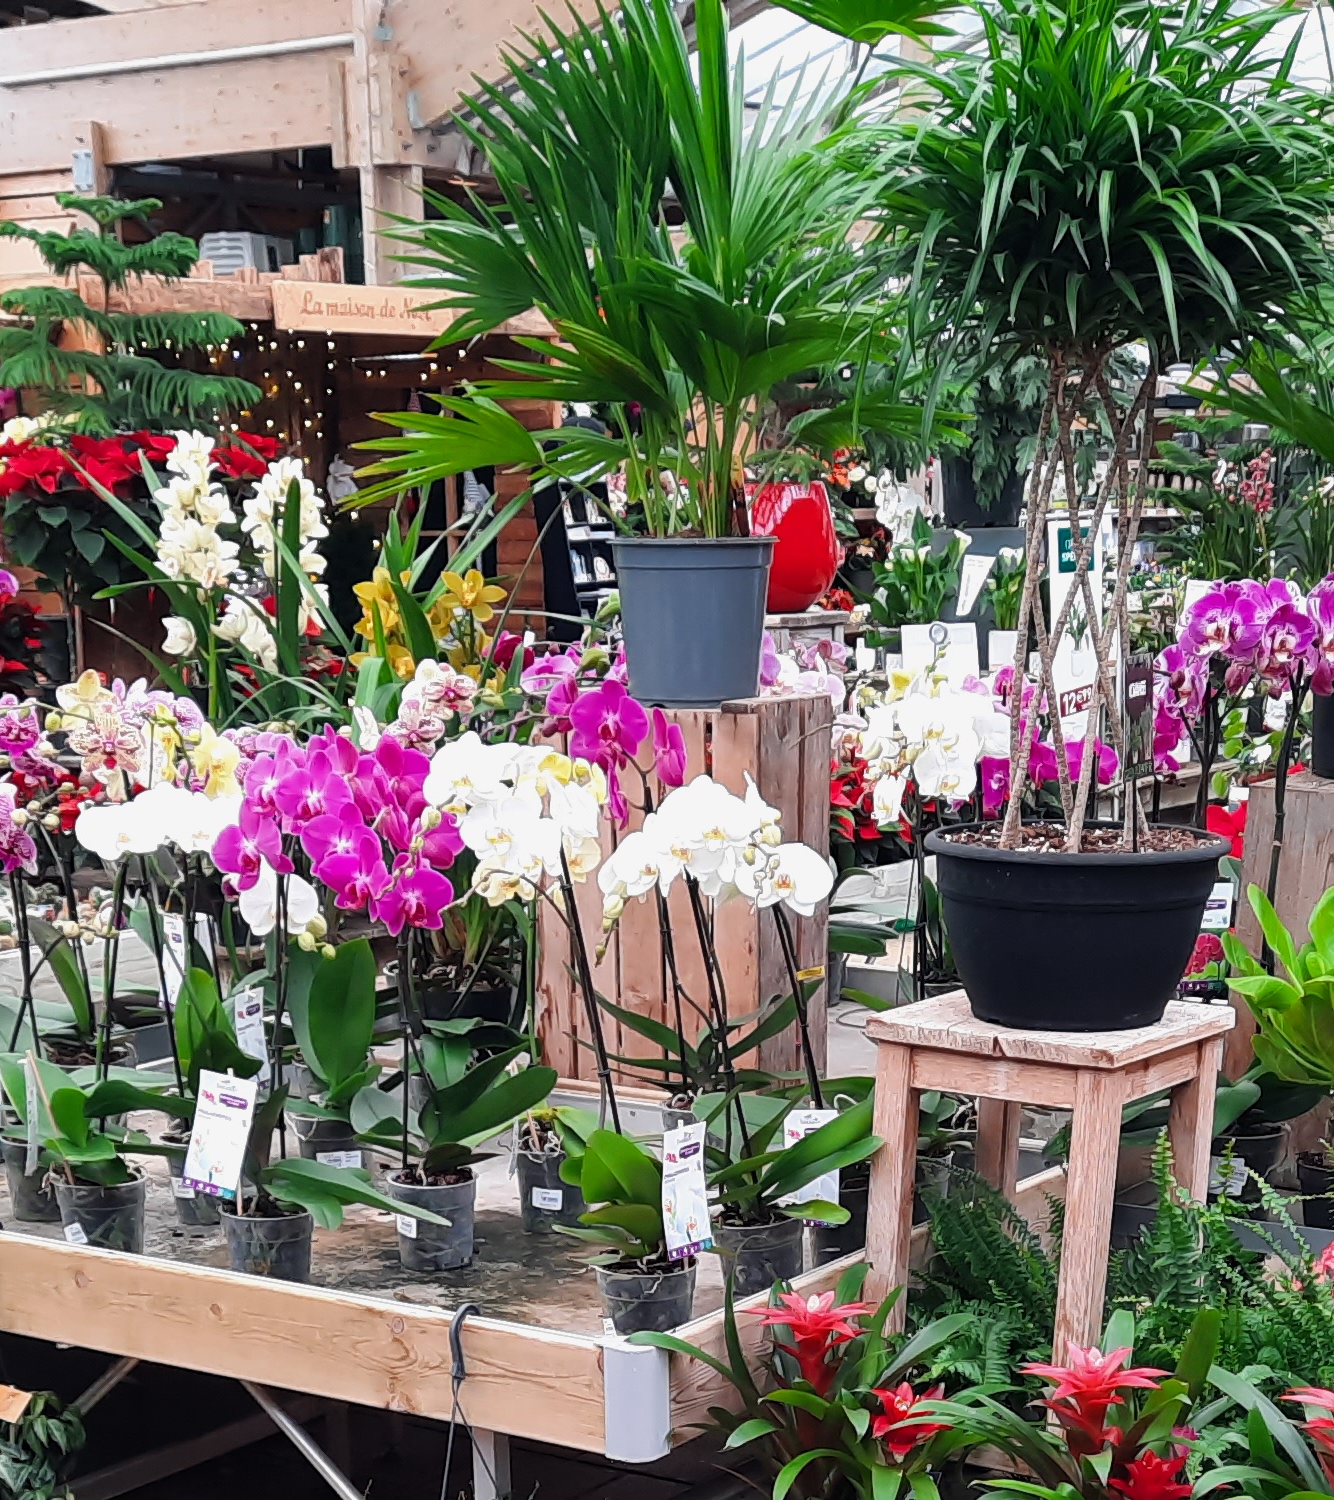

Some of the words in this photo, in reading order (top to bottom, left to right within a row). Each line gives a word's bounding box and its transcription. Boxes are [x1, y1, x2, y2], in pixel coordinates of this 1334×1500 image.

[300, 289, 323, 315] La
[326, 297, 375, 319] maison
[379, 298, 396, 318] de
